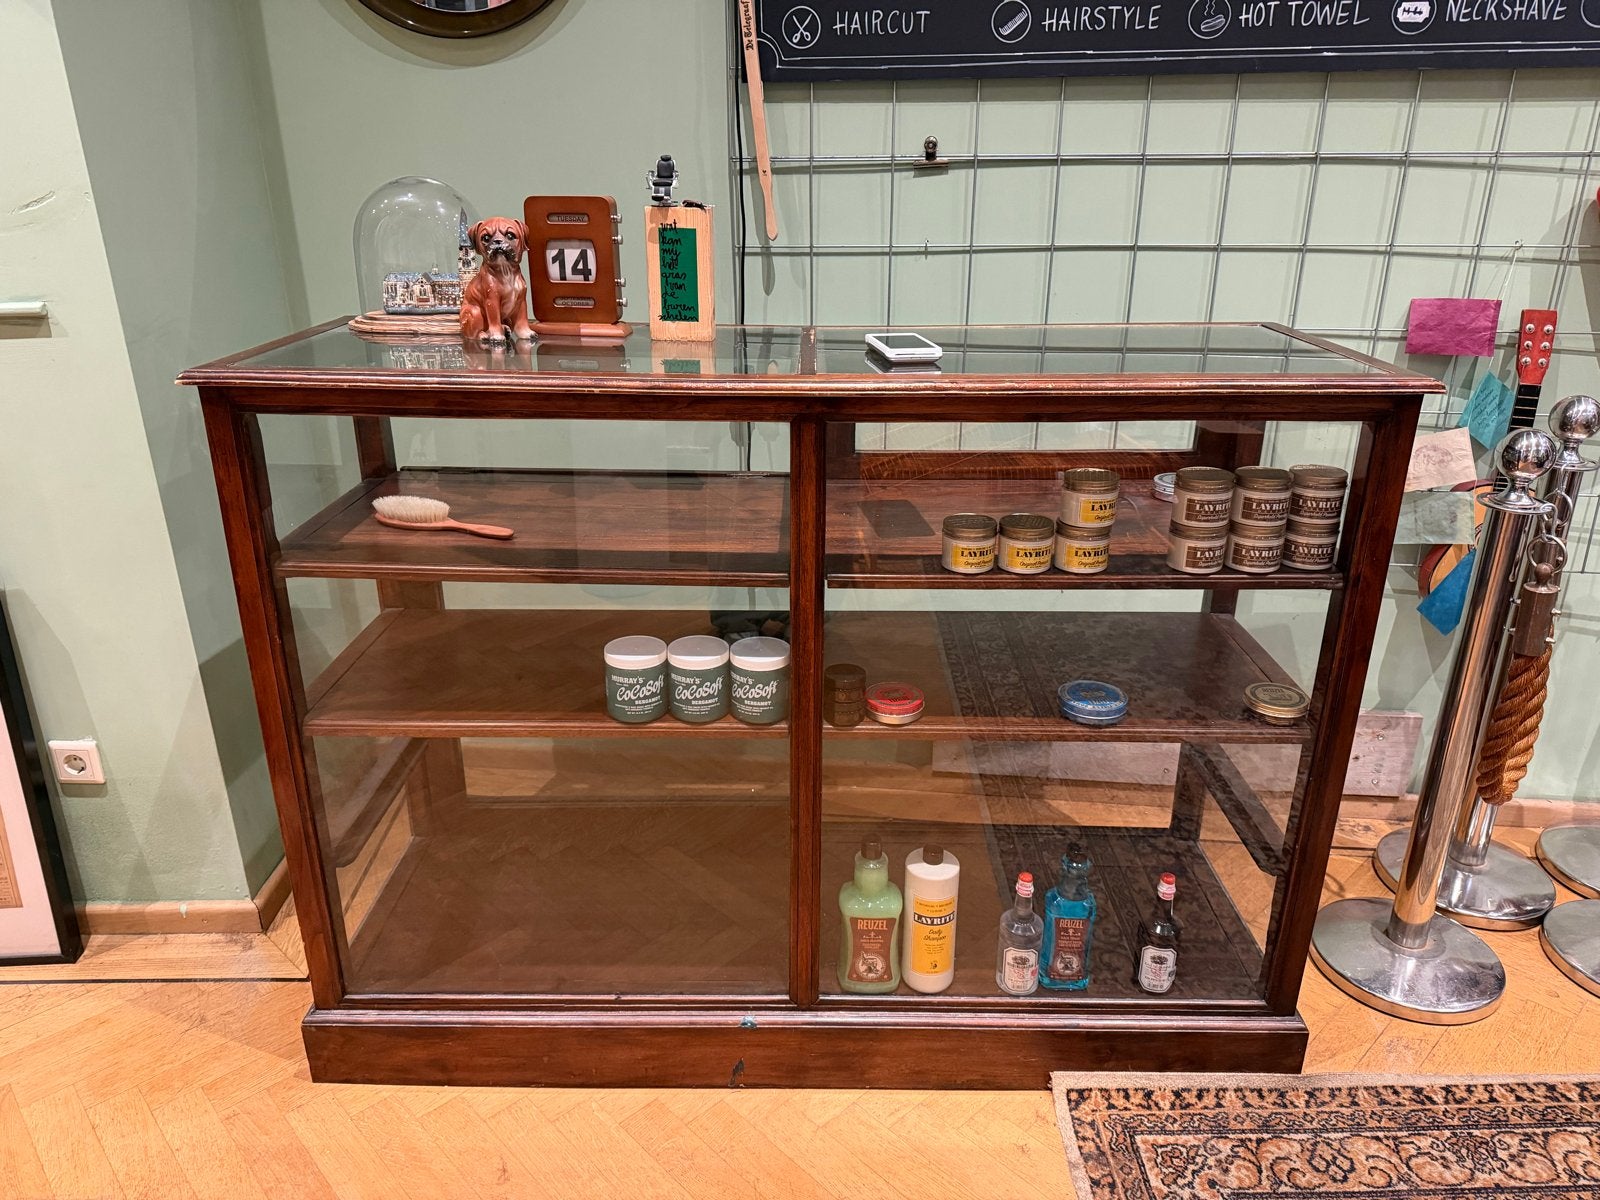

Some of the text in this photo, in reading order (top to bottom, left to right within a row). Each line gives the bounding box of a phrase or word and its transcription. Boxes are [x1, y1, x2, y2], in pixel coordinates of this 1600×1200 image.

[1238, 0, 1370, 28] HOT TOWEL
[1445, 0, 1568, 23] NECKSHAVE
[832, 11, 931, 36] HAIRCUT
[1041, 4, 1162, 34] HAIRSTYLE
[745, 39, 754, 51] De
[551, 248, 592, 282] 14
[961, 548, 994, 558] LAYRIT
[611, 674, 644, 684] MURRAY'S
[857, 919, 888, 930] REUZEL
[914, 911, 955, 925] LAYRITE
[1059, 918, 1084, 929] REUZEL
